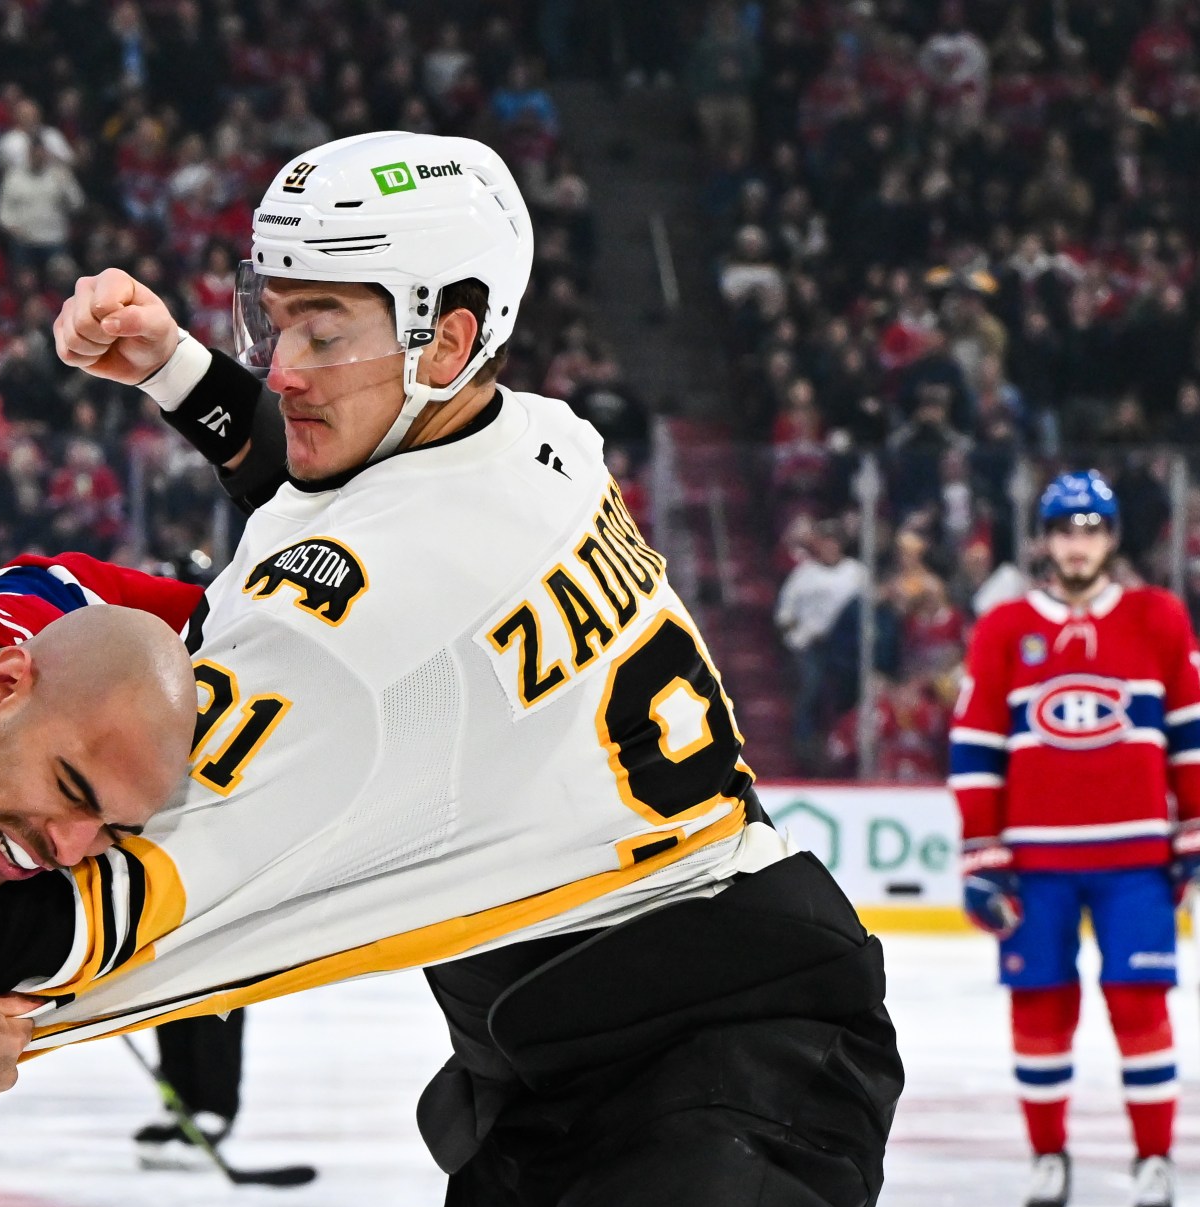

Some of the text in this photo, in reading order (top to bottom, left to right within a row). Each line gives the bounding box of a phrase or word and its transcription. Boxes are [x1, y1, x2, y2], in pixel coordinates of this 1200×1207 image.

[284, 162, 319, 187] 91
[375, 160, 464, 189] TD Bank
[258, 213, 302, 227] WARRIOR
[274, 544, 351, 589] BOSTON
[486, 477, 667, 710] ZADOR
